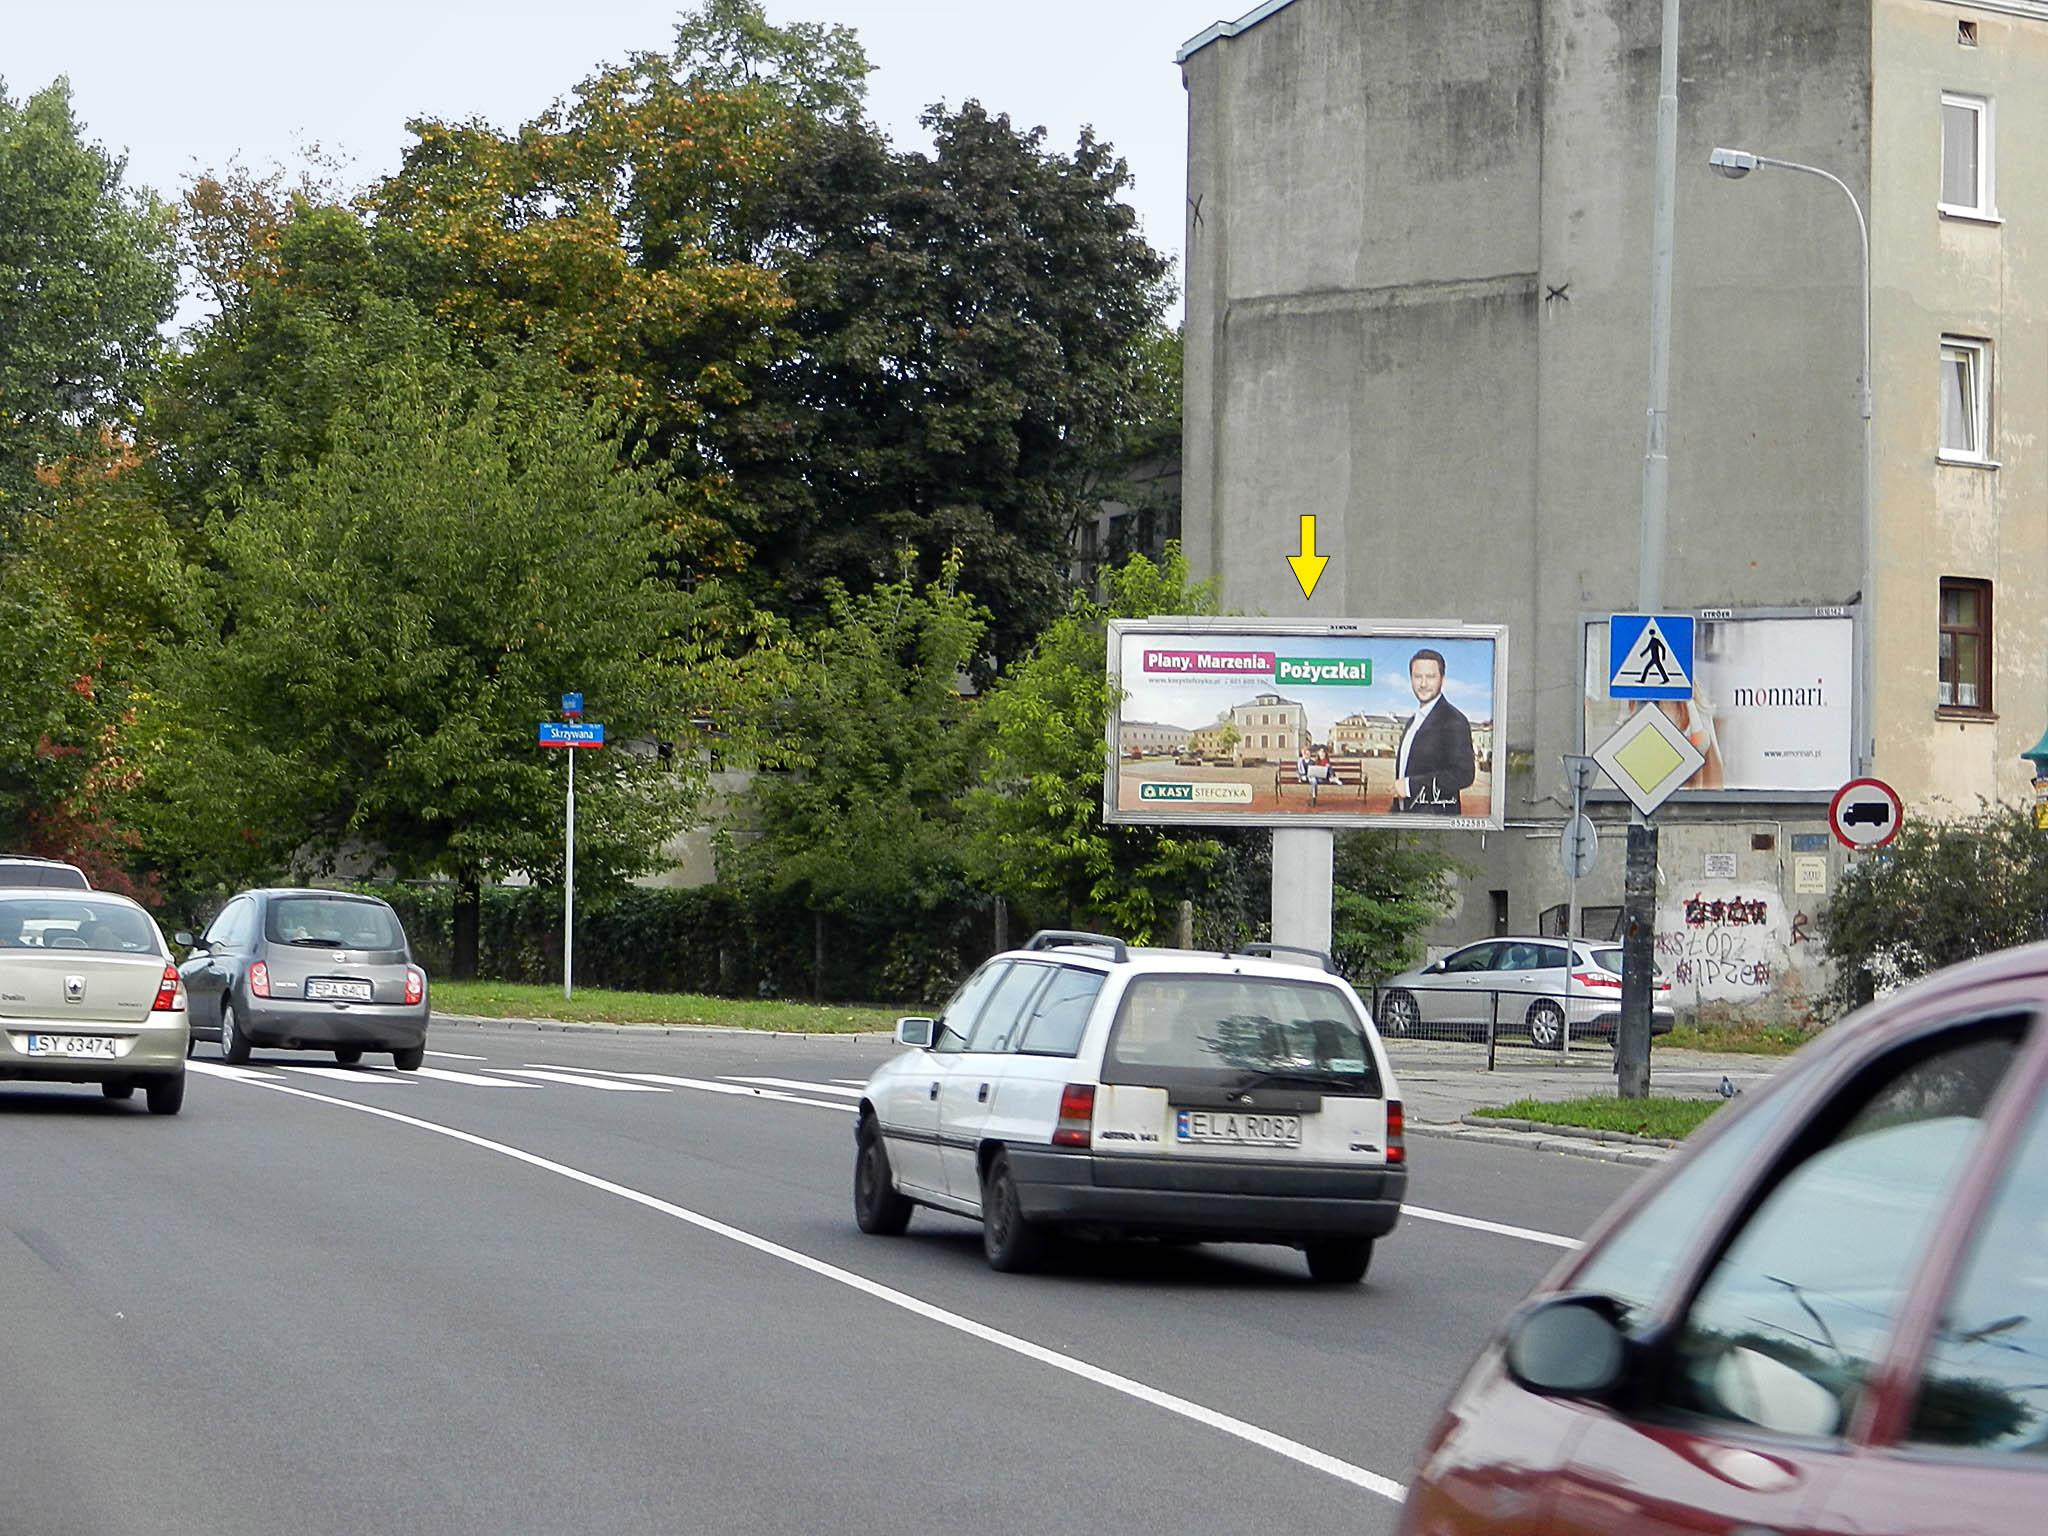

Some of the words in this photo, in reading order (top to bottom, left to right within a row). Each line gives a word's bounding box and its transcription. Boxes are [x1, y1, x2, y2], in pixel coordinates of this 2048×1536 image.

[1148, 653, 1193, 671] Plany.
[1198, 654, 1270, 669] Marzenia.
[1280, 661, 1366, 682] Pożyczka!
[1735, 678, 1822, 706] monnari
[551, 728, 594, 740] Skrzywana
[1158, 786, 1190, 797] KASY
[1195, 788, 1247, 799] STEFCZYKA
[315, 984, 338, 995] EPA
[39, 1036, 59, 1050] SY
[66, 1037, 112, 1053] 63474
[1193, 1114, 1239, 1137] ELA
[1248, 1116, 1298, 1139] R082
